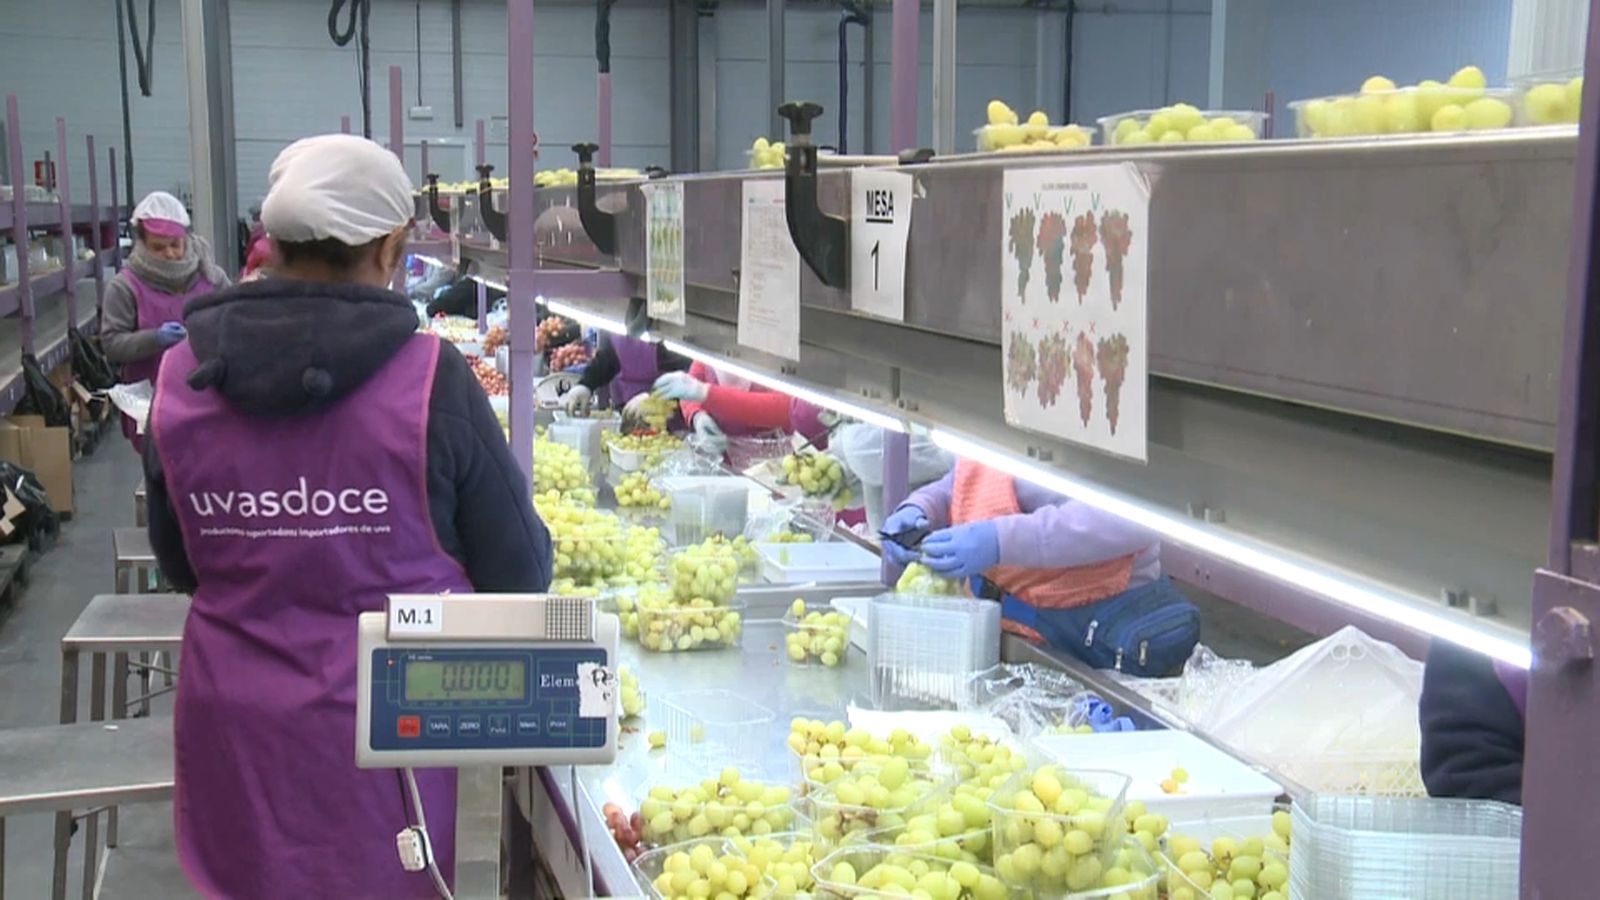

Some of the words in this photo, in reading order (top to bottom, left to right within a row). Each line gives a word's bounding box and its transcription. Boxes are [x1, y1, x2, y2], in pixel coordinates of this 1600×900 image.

[865, 189, 894, 216] MESA
[871, 240, 879, 291] 1
[189, 476, 389, 517] uvasdoce
[398, 608, 433, 624] M.1
[459, 722, 480, 730] ZERO
